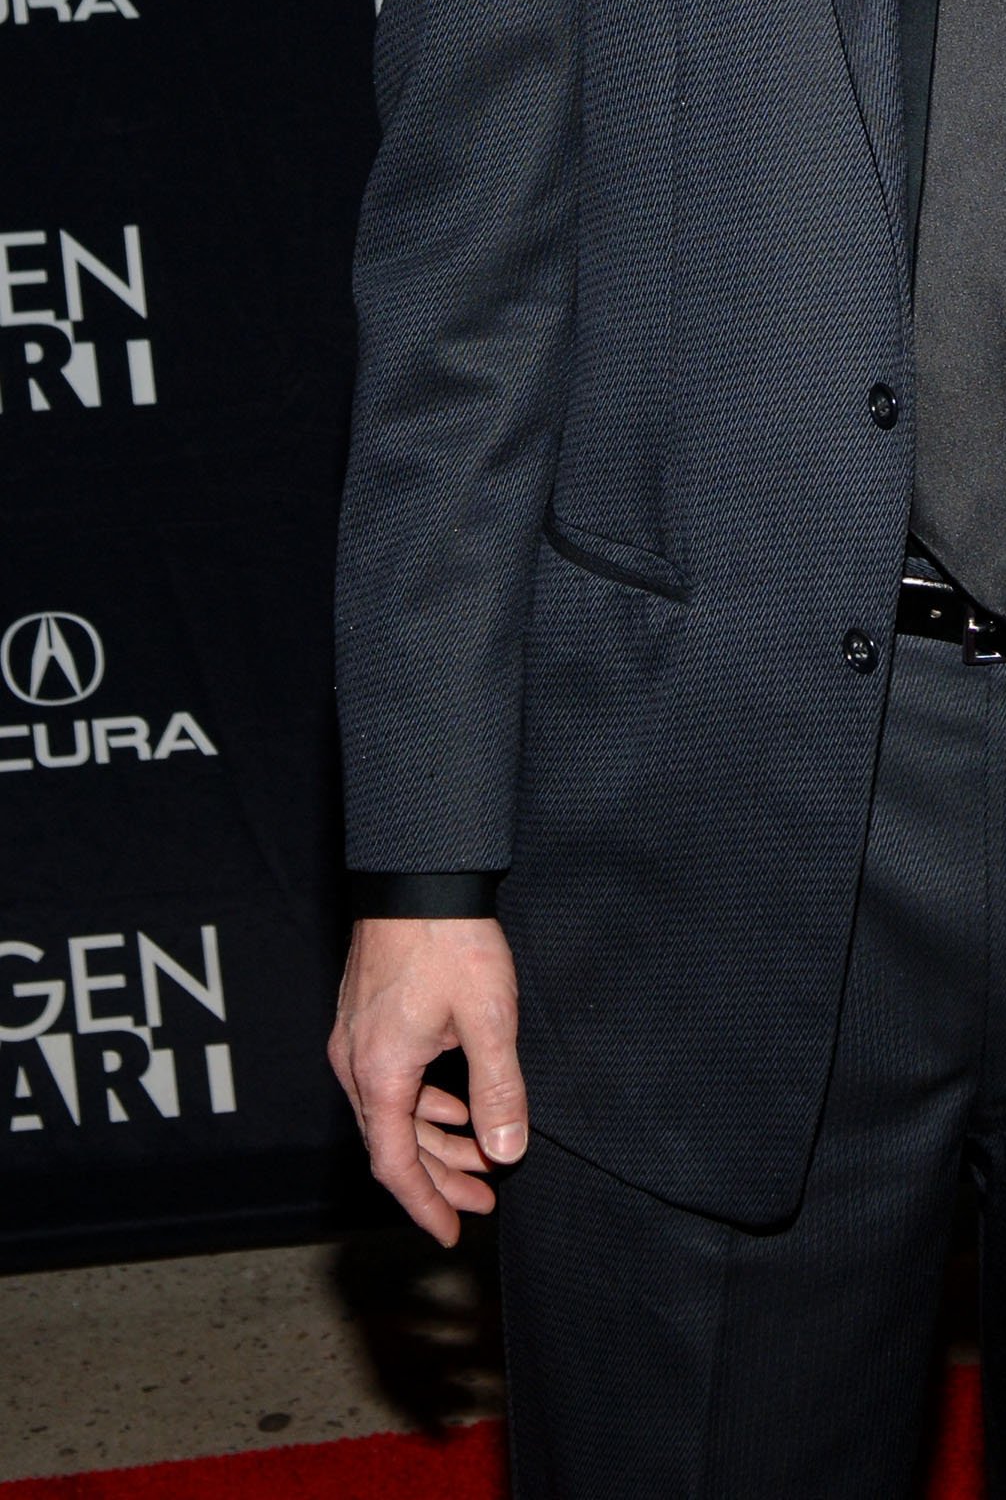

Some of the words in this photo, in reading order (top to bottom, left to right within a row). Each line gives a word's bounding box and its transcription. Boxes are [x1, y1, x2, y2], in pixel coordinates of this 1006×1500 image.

[0, 225, 147, 323] EN
[0, 320, 157, 412] RT
[0, 712, 218, 772] CURA
[0, 924, 226, 1043] GEN
